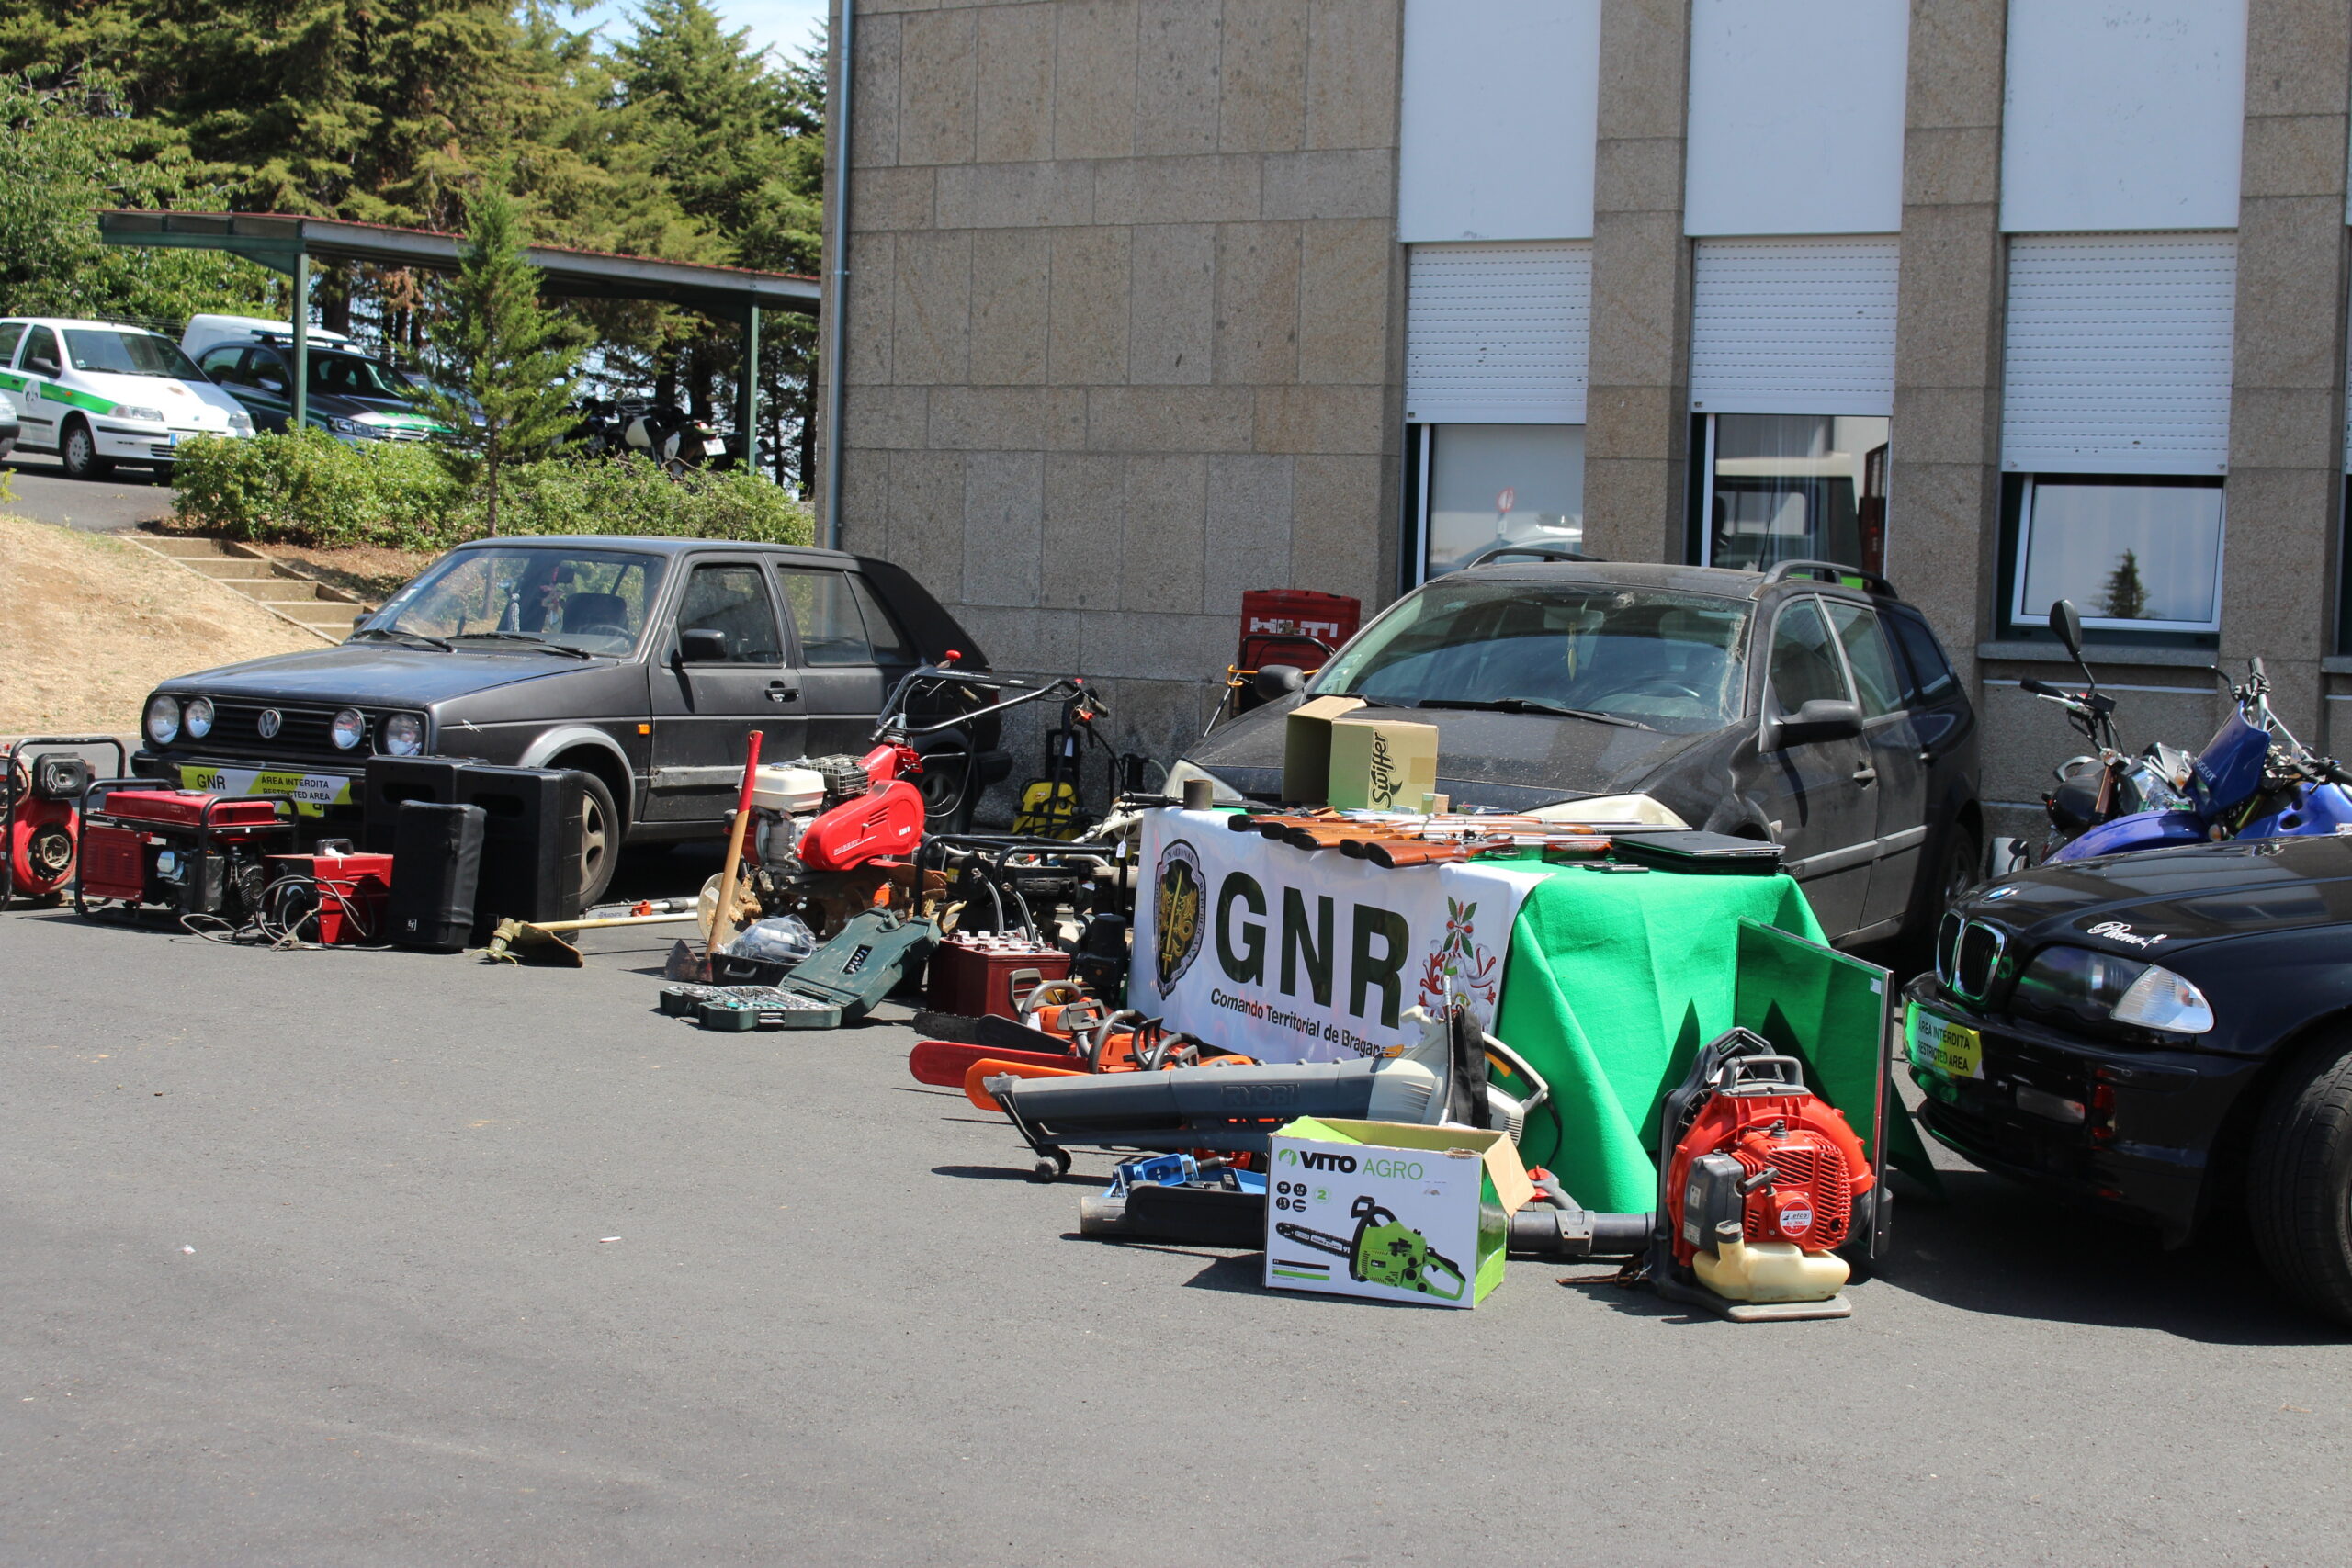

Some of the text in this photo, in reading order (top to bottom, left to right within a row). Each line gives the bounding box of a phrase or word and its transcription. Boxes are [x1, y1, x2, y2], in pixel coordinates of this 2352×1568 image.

[196, 773, 226, 790] GNR
[1370, 730, 1396, 809] Swiffer
[263, 788, 331, 801] RESTRICTED AREA
[286, 777, 329, 789] INTERDITA
[1215, 871, 1409, 1031] GNR
[1210, 988, 1386, 1058] Comando Territorial de Bragan
[1932, 1026, 1970, 1050] INTERDITA
[1917, 1039, 1970, 1071] RESTRICTED AREA
[1224, 1085, 1295, 1105] RYOBI
[1299, 1150, 1424, 1181] VITO AGRO
[1317, 1190, 1327, 1200] 2
